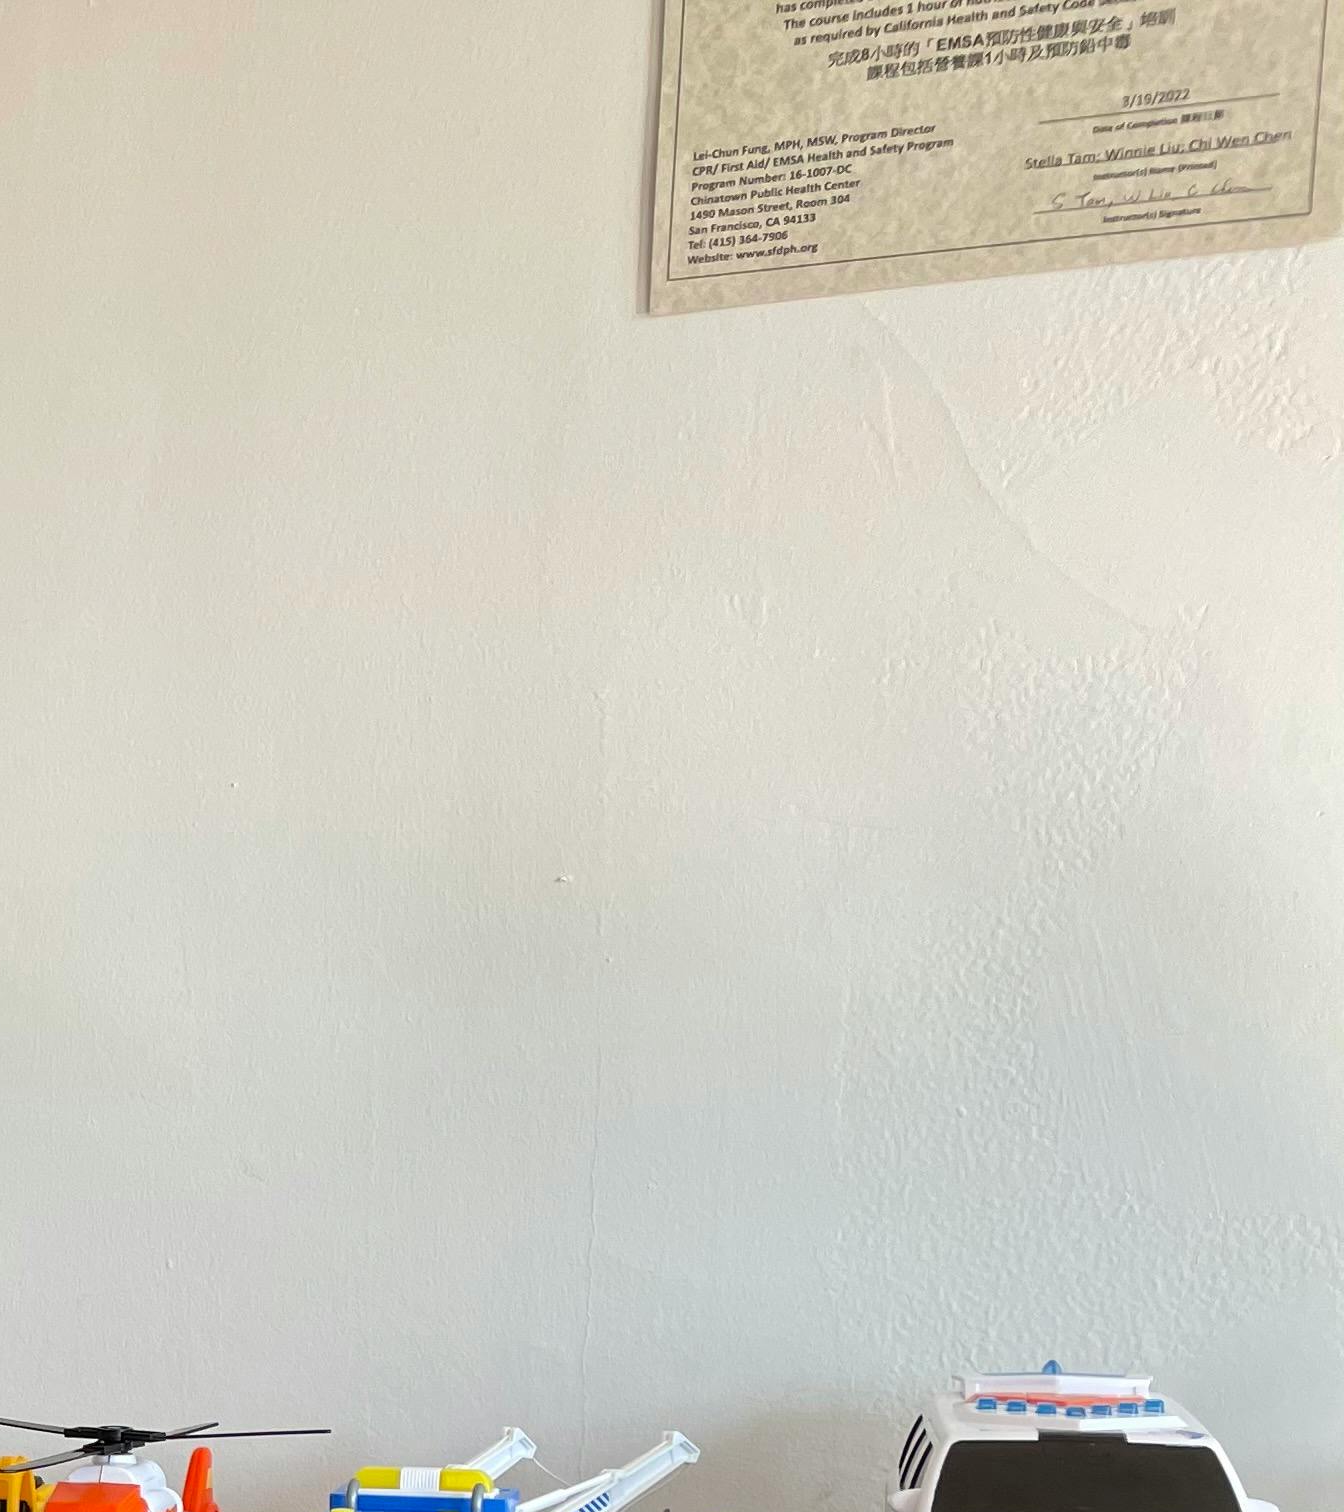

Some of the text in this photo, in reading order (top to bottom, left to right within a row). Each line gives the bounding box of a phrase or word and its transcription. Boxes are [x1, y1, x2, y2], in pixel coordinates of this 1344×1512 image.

[776, 3, 797, 14] has
[783, 17, 805, 30] The
[809, 15, 849, 27] course
[852, 7, 903, 21] includes
[916, 0, 947, 12] hour
[793, 36, 807, 46] as
[810, 25, 862, 45] required
[865, 24, 881, 37] by
[883, 17, 943, 34] California
[946, 9, 988, 25] Health
[991, 8, 1016, 20] and
[1019, 3, 1060, 16] Safety
[692, 137, 954, 178] CPR/ First Aid/ EMSA Health and Safety Program
[693, 124, 936, 162] Lei-Chun Fung, MPH, MSW, Program Director
[1023, 155, 1062, 170] Stella
[1104, 146, 1156, 161] Winnie
[1188, 138, 1212, 151] Chi
[1215, 134, 1250, 149] Wen
[1253, 129, 1293, 145] Chen
[690, 178, 860, 206] Chinatown Public Health Center
[691, 163, 853, 193] Program Number: 16-1007-DC
[718, 204, 755, 218] Mason
[757, 200, 793, 214] Street,
[795, 196, 828, 210] Room
[830, 193, 850, 205] 304
[688, 213, 817, 237] San Francisco, CA 94133
[687, 242, 818, 265] Website: www.sfdph.org
[688, 231, 789, 251] Tel: (415) 364-7906
